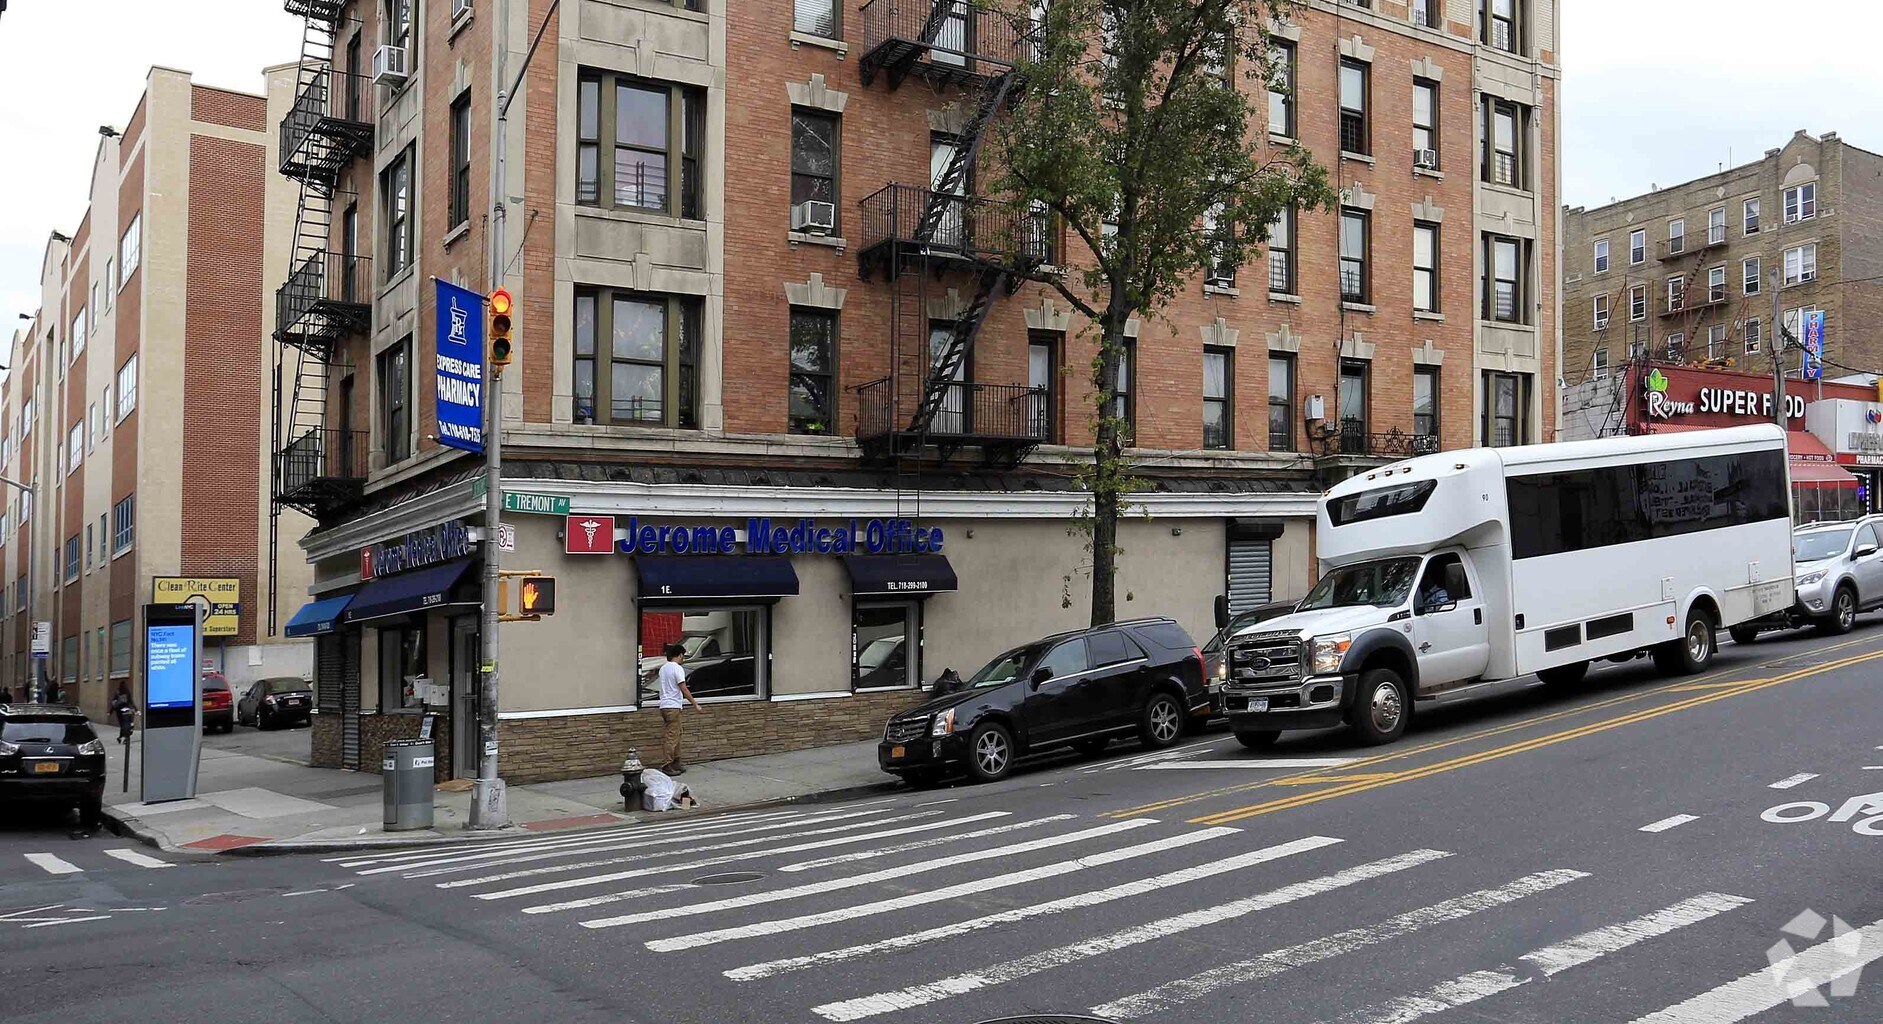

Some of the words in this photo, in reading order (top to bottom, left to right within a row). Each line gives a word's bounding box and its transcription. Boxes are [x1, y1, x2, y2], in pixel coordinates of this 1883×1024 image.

[437, 353, 462, 376] EXPRESS
[463, 362, 481, 379] CARE
[437, 374, 481, 407] PHARMACY
[1700, 387, 1757, 416] SUPER
[1762, 392, 1805, 418] FOD
[1649, 391, 1694, 419] Reyna
[505, 493, 511, 509] E
[516, 494, 556, 512] TREMONT
[558, 498, 566, 507] AV
[620, 516, 737, 555] Jerome
[746, 517, 856, 554] Medical
[866, 518, 945, 554] Office
[158, 580, 183, 592] Clean
[184, 580, 207, 592] Rite
[208, 580, 236, 592] Center
